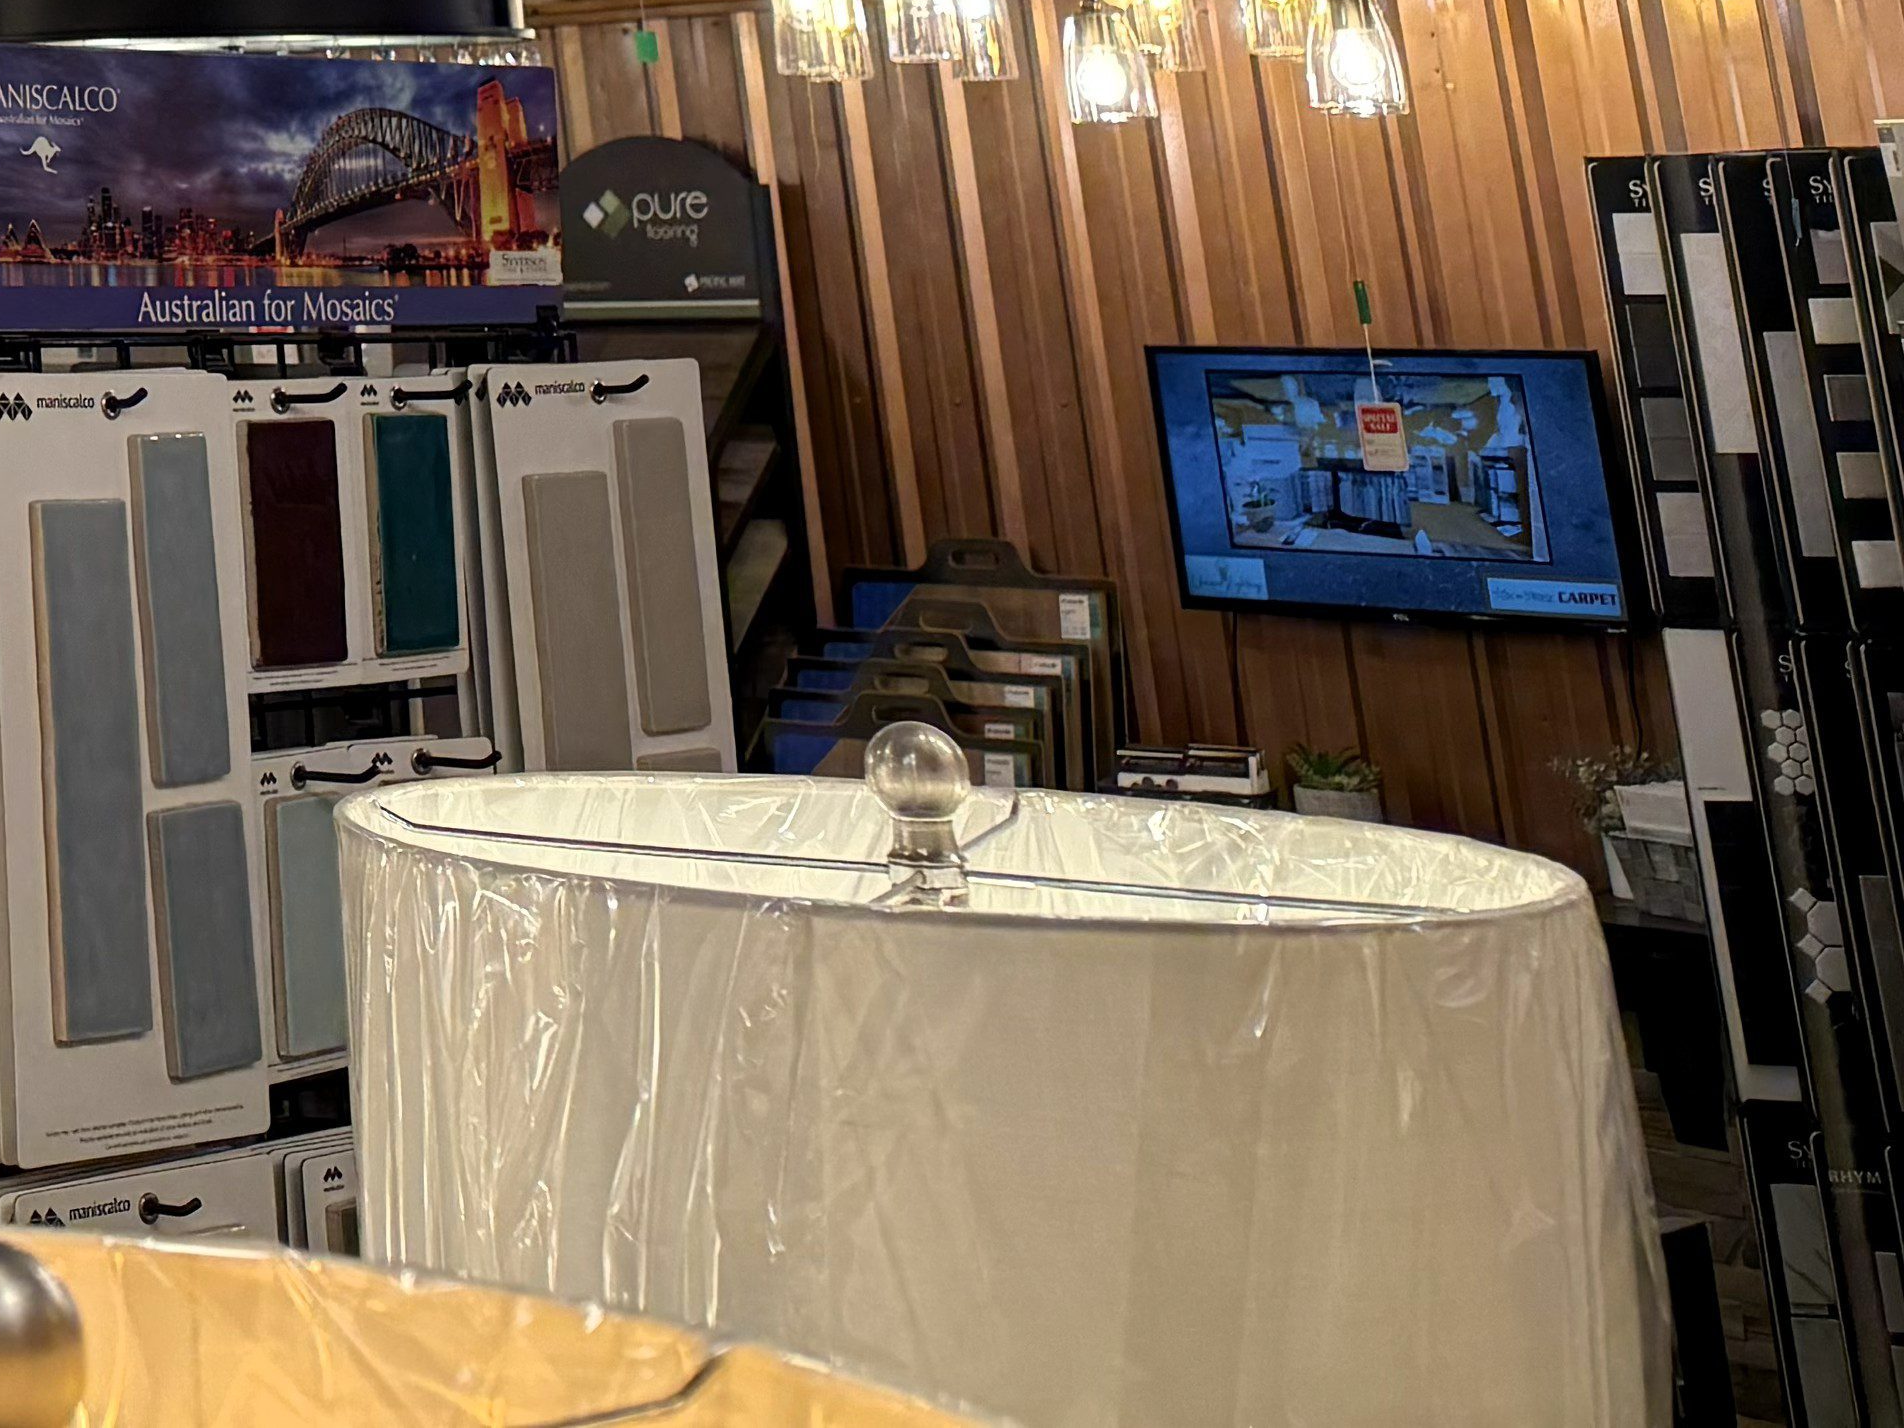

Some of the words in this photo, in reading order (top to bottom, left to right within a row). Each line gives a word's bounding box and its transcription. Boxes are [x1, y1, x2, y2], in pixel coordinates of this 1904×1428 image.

[631, 191, 709, 228] pure
[138, 290, 254, 322] Australian
[263, 289, 294, 322] for
[303, 291, 394, 322] Mosaics
[535, 379, 585, 395] maniscalco
[36, 394, 95, 410] maniscalco
[69, 1197, 130, 1221] maniscalco
